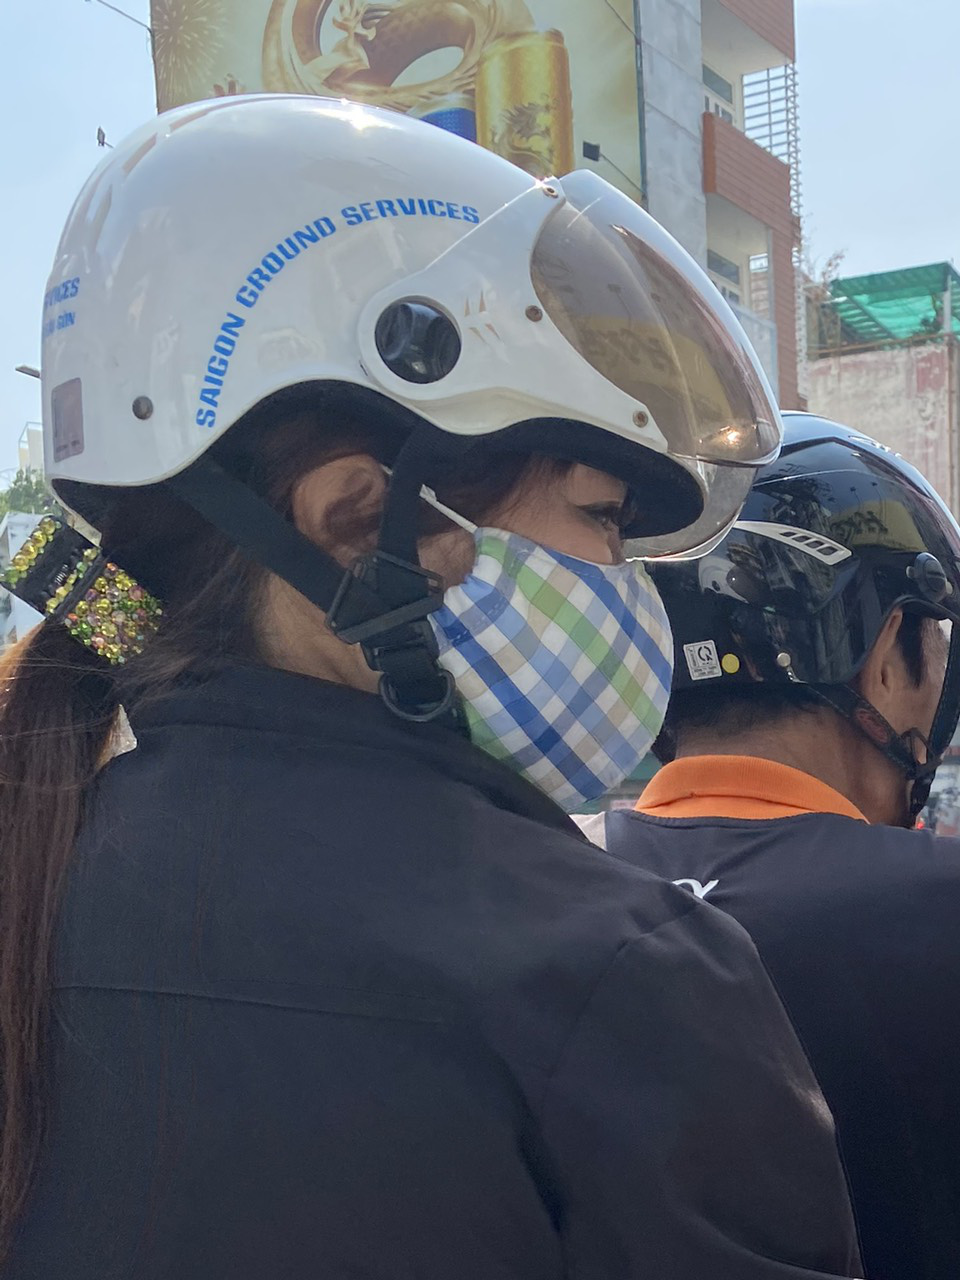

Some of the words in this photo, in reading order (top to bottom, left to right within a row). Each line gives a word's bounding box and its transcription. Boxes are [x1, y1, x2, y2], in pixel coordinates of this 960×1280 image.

[195, 312, 246, 428] SAIGON
[235, 216, 337, 309] GROUND
[341, 198, 480, 225] SERVICES
